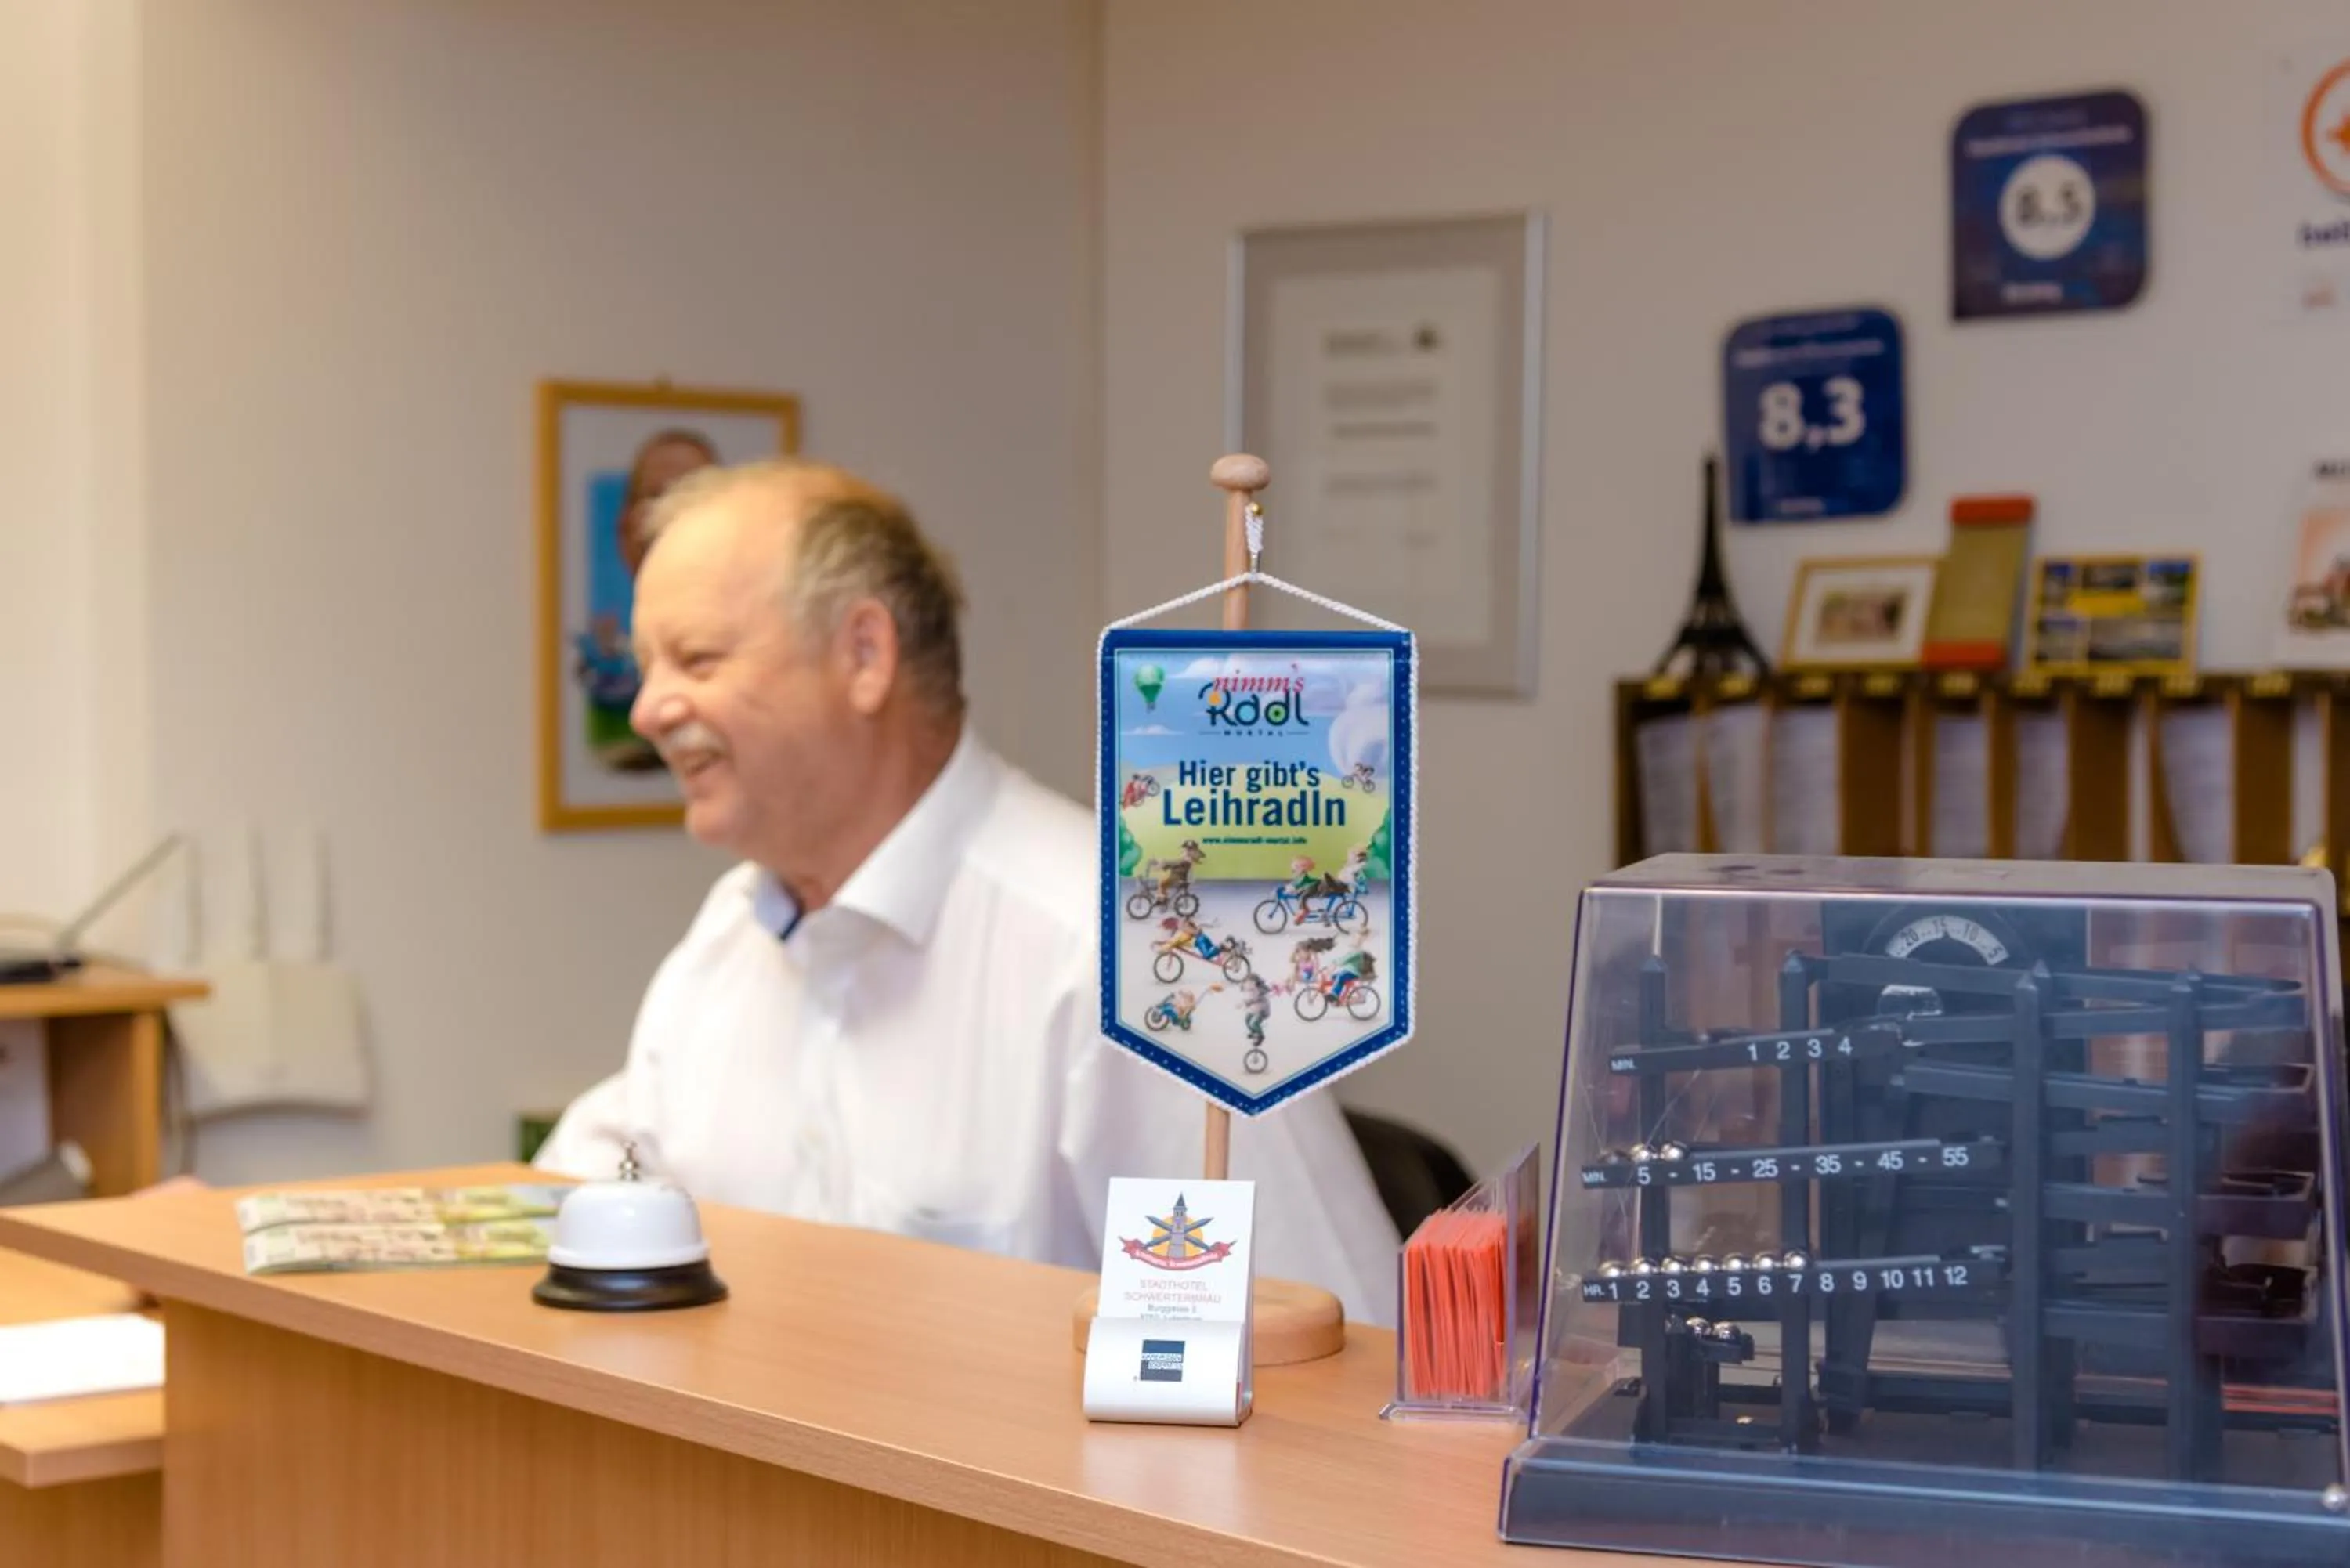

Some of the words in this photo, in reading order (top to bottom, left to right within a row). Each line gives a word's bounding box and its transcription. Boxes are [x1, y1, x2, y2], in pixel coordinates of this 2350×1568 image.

[1758, 374, 1867, 452] 8,3
[1179, 760, 1236, 786] Hier
[1246, 760, 1321, 793] gibt's
[1964, 923, 1980, 941] 10
[1747, 1043, 1759, 1062] 1
[1776, 1041, 1791, 1060] 2
[1807, 1038, 1822, 1057] 3
[1838, 1035, 1853, 1055] 4
[1637, 1165, 1651, 1185] 5
[1692, 1162, 1716, 1182] 15
[1752, 1158, 1779, 1178] 25
[1815, 1154, 1842, 1174] 35
[1877, 1151, 1904, 1170] 45
[1942, 1147, 1969, 1166] 55
[1608, 1281, 1618, 1300] 1
[1636, 1281, 1650, 1299] 2
[1666, 1279, 1681, 1298] 3
[1695, 1277, 1711, 1296] 4
[1727, 1277, 1741, 1295] 5
[1757, 1275, 1772, 1294] 6
[1788, 1274, 1802, 1293] 7
[1819, 1273, 1835, 1292] 8
[1852, 1271, 1867, 1291] 9
[1880, 1269, 1904, 1289] 10
[1911, 1267, 1935, 1287] 11
[1943, 1266, 1968, 1286] 12
